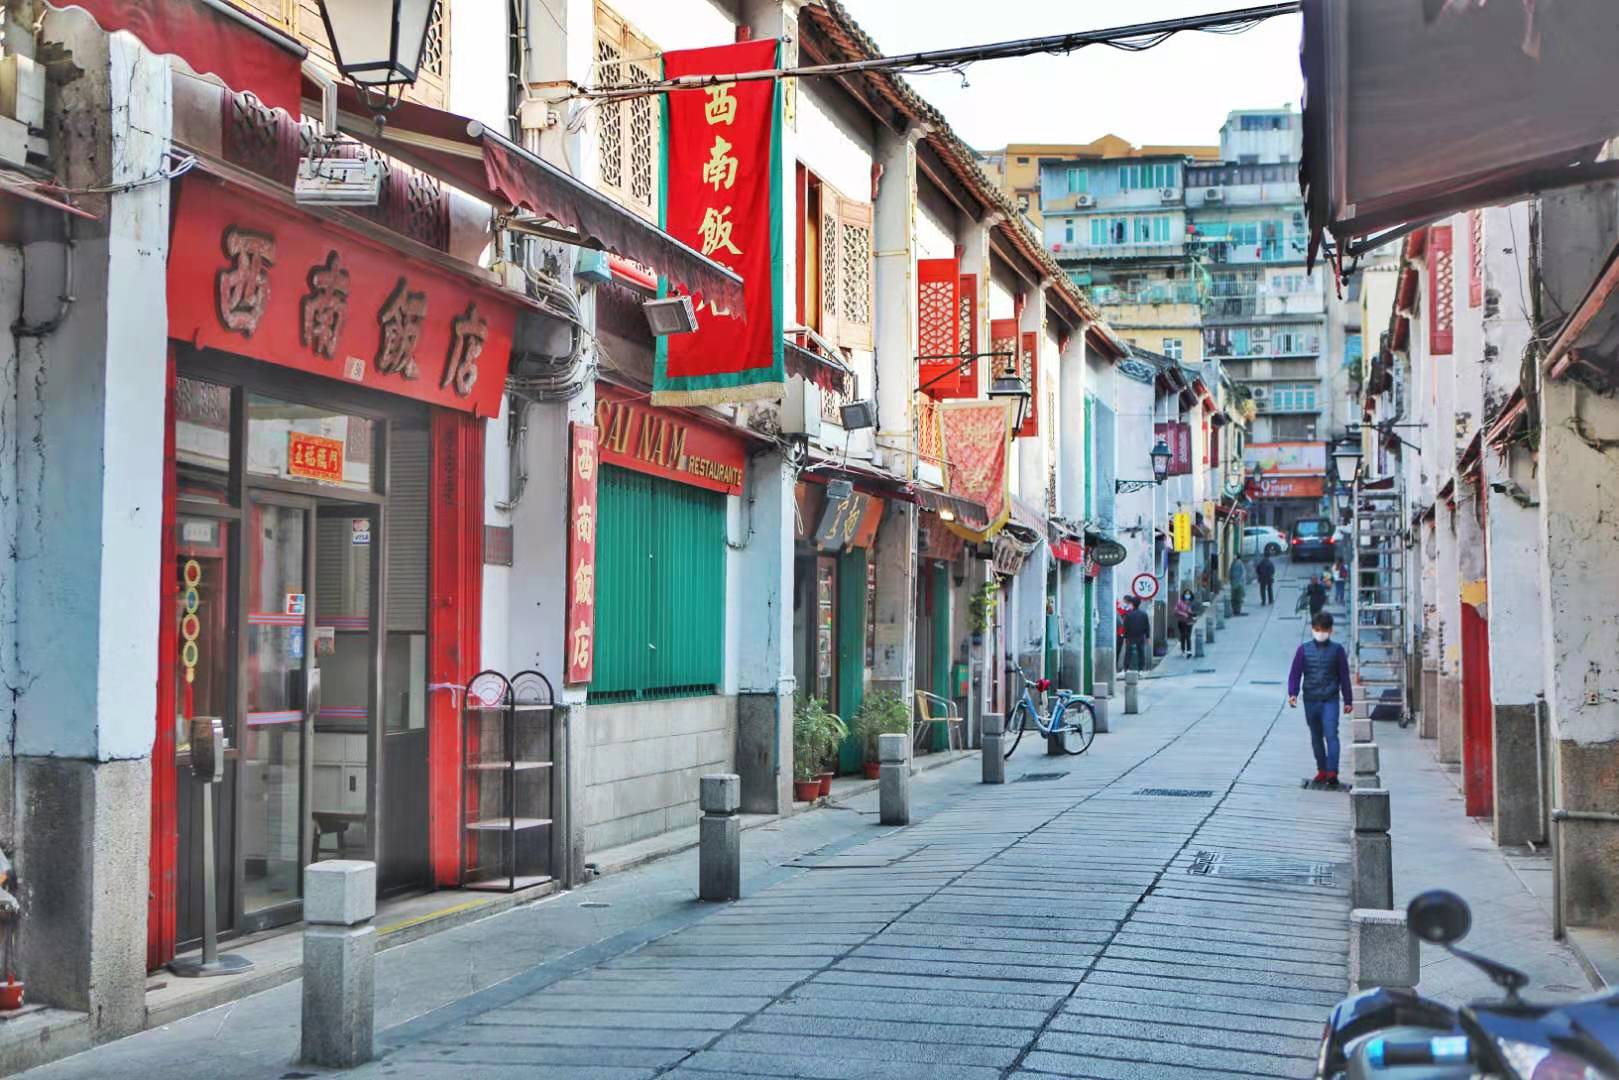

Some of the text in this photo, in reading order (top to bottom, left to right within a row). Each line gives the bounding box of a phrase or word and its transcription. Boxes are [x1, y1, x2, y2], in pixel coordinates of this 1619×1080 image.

[697, 83, 744, 316] 西南飯
[214, 223, 488, 398] 西南飯店
[597, 398, 743, 486] SAI NAM RESTAURANTE
[573, 439, 594, 669] 西南飯店
